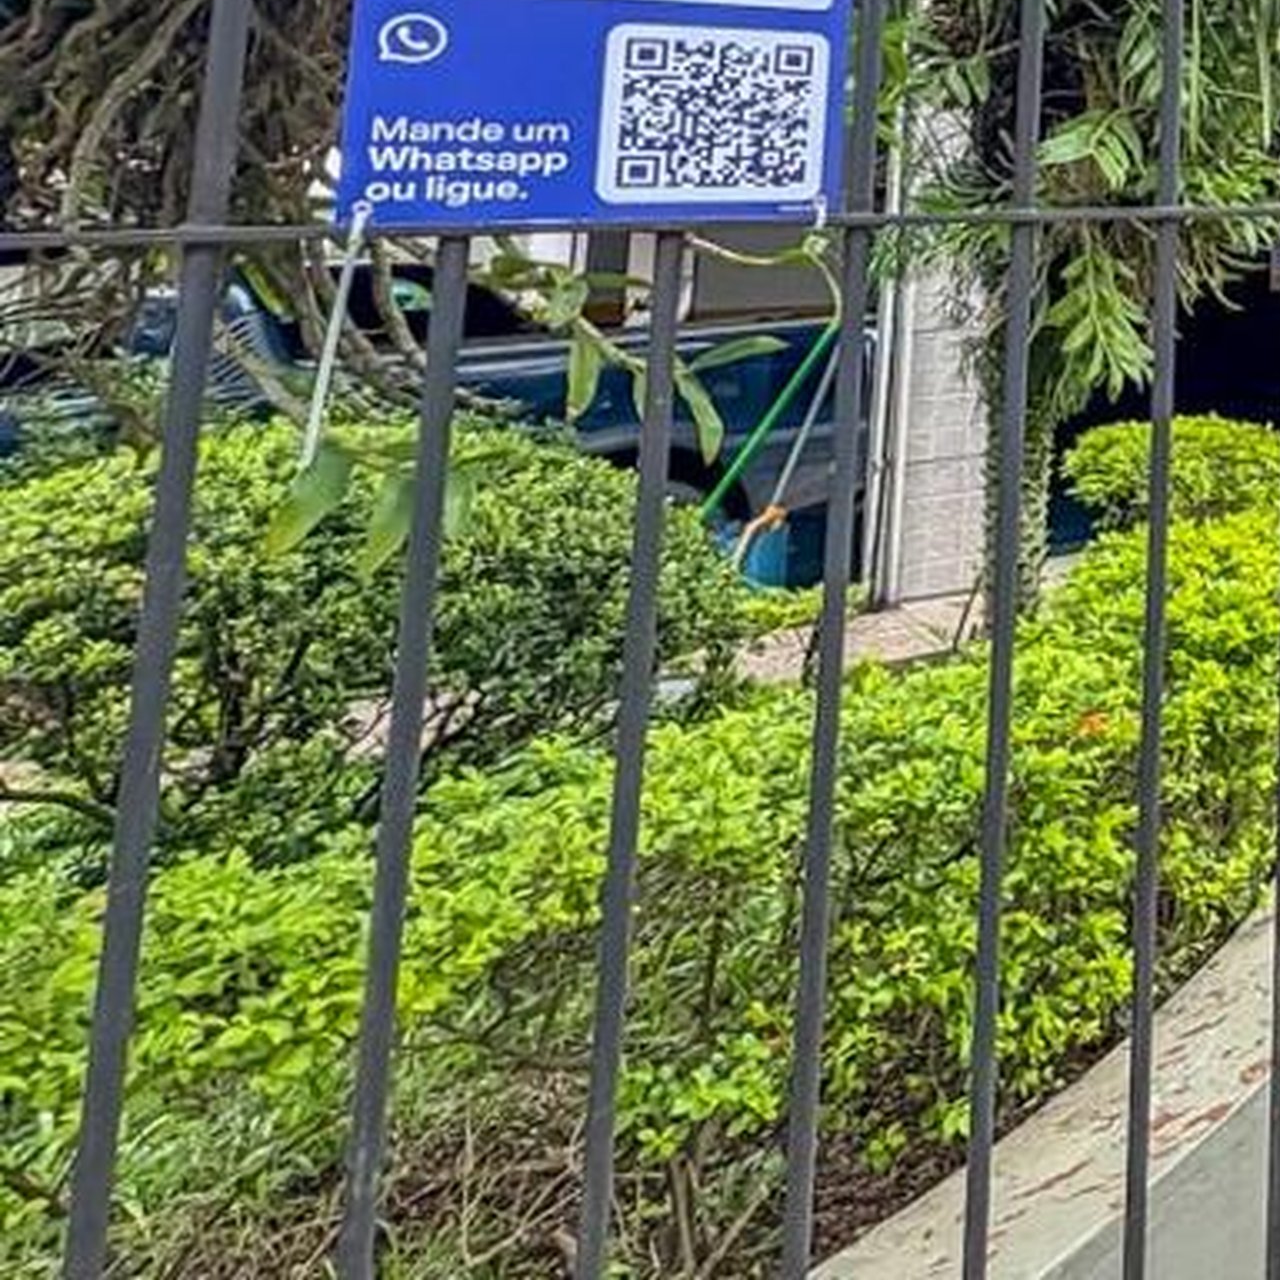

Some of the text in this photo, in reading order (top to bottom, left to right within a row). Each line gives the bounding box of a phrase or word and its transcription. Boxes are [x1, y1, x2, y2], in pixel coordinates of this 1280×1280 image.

[371, 116, 570, 142] Mande um
[368, 145, 568, 177] Whatsapp
[364, 174, 528, 208] ou ligue.
